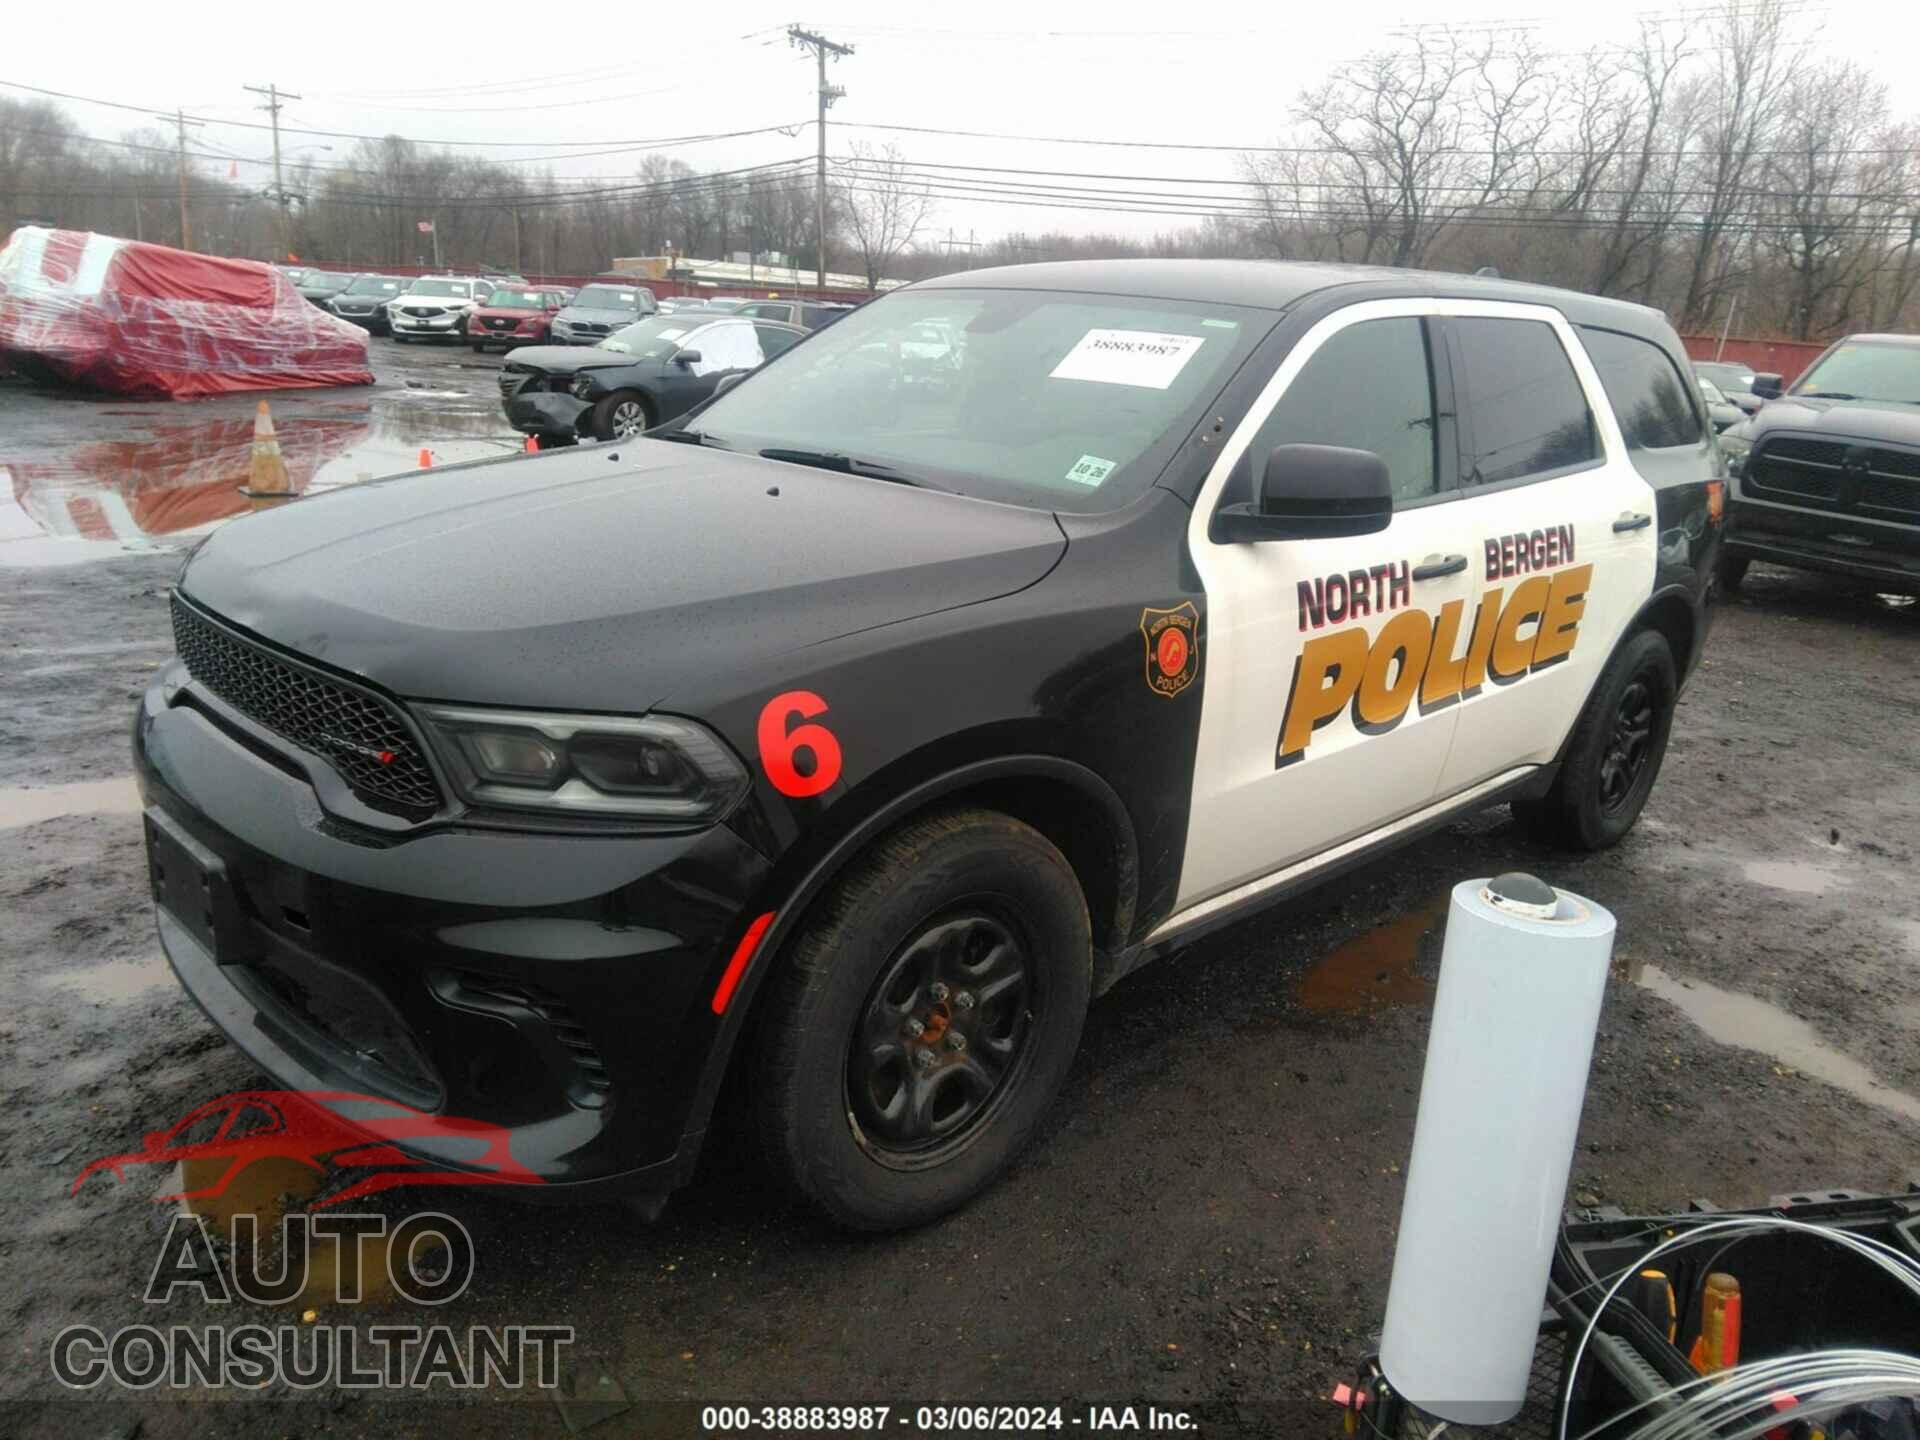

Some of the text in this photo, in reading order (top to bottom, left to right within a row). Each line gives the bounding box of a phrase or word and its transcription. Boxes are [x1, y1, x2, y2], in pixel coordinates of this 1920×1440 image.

[1297, 524, 1575, 632] NORTH BERGEN
[1275, 564, 1594, 769] POLICE
[758, 690, 842, 798] 6
